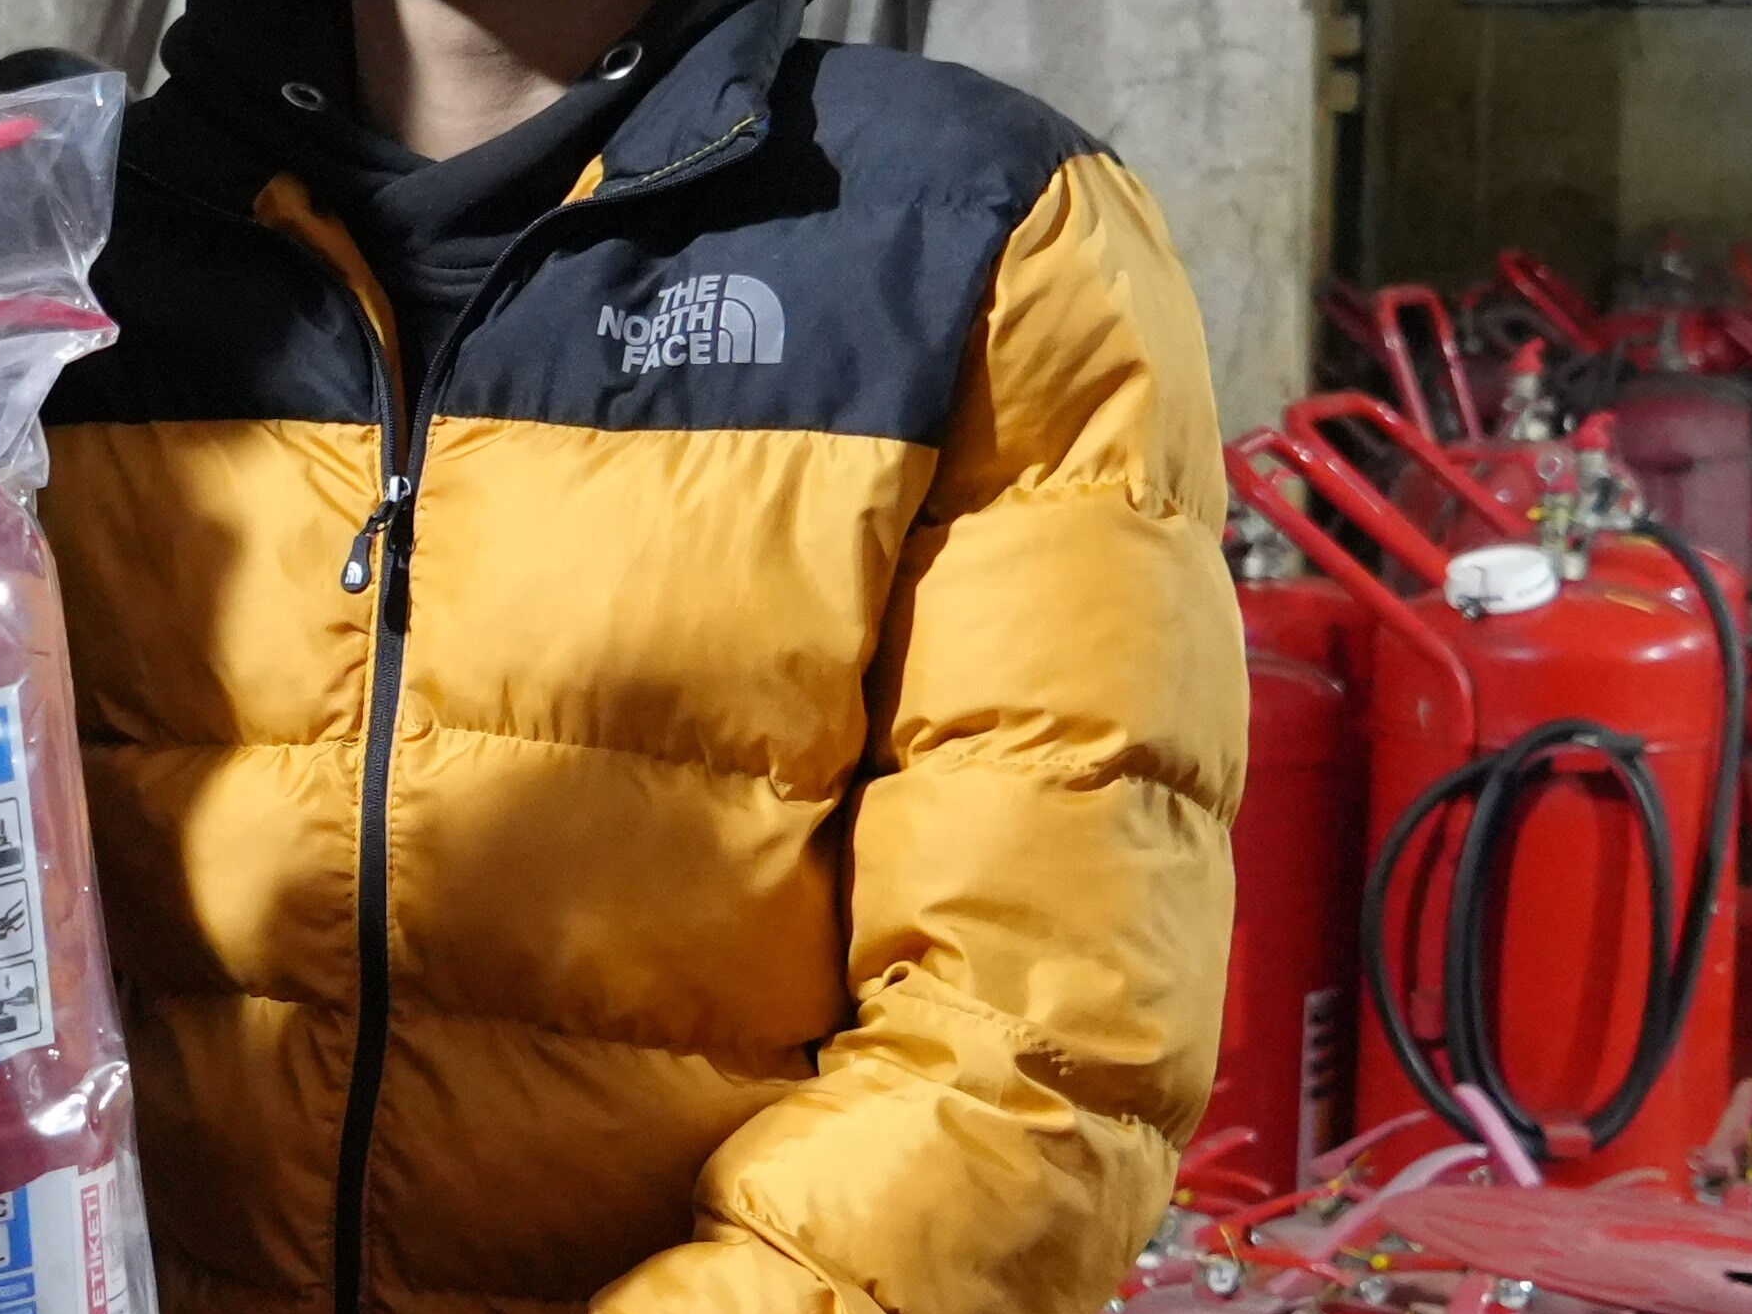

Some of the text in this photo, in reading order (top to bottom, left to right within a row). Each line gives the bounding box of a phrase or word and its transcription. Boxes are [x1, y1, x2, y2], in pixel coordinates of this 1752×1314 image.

[658, 274, 722, 314] THE
[596, 301, 715, 346] NORTH
[621, 332, 711, 375] FACE
[83, 1192, 106, 1308] ETİKETİ
